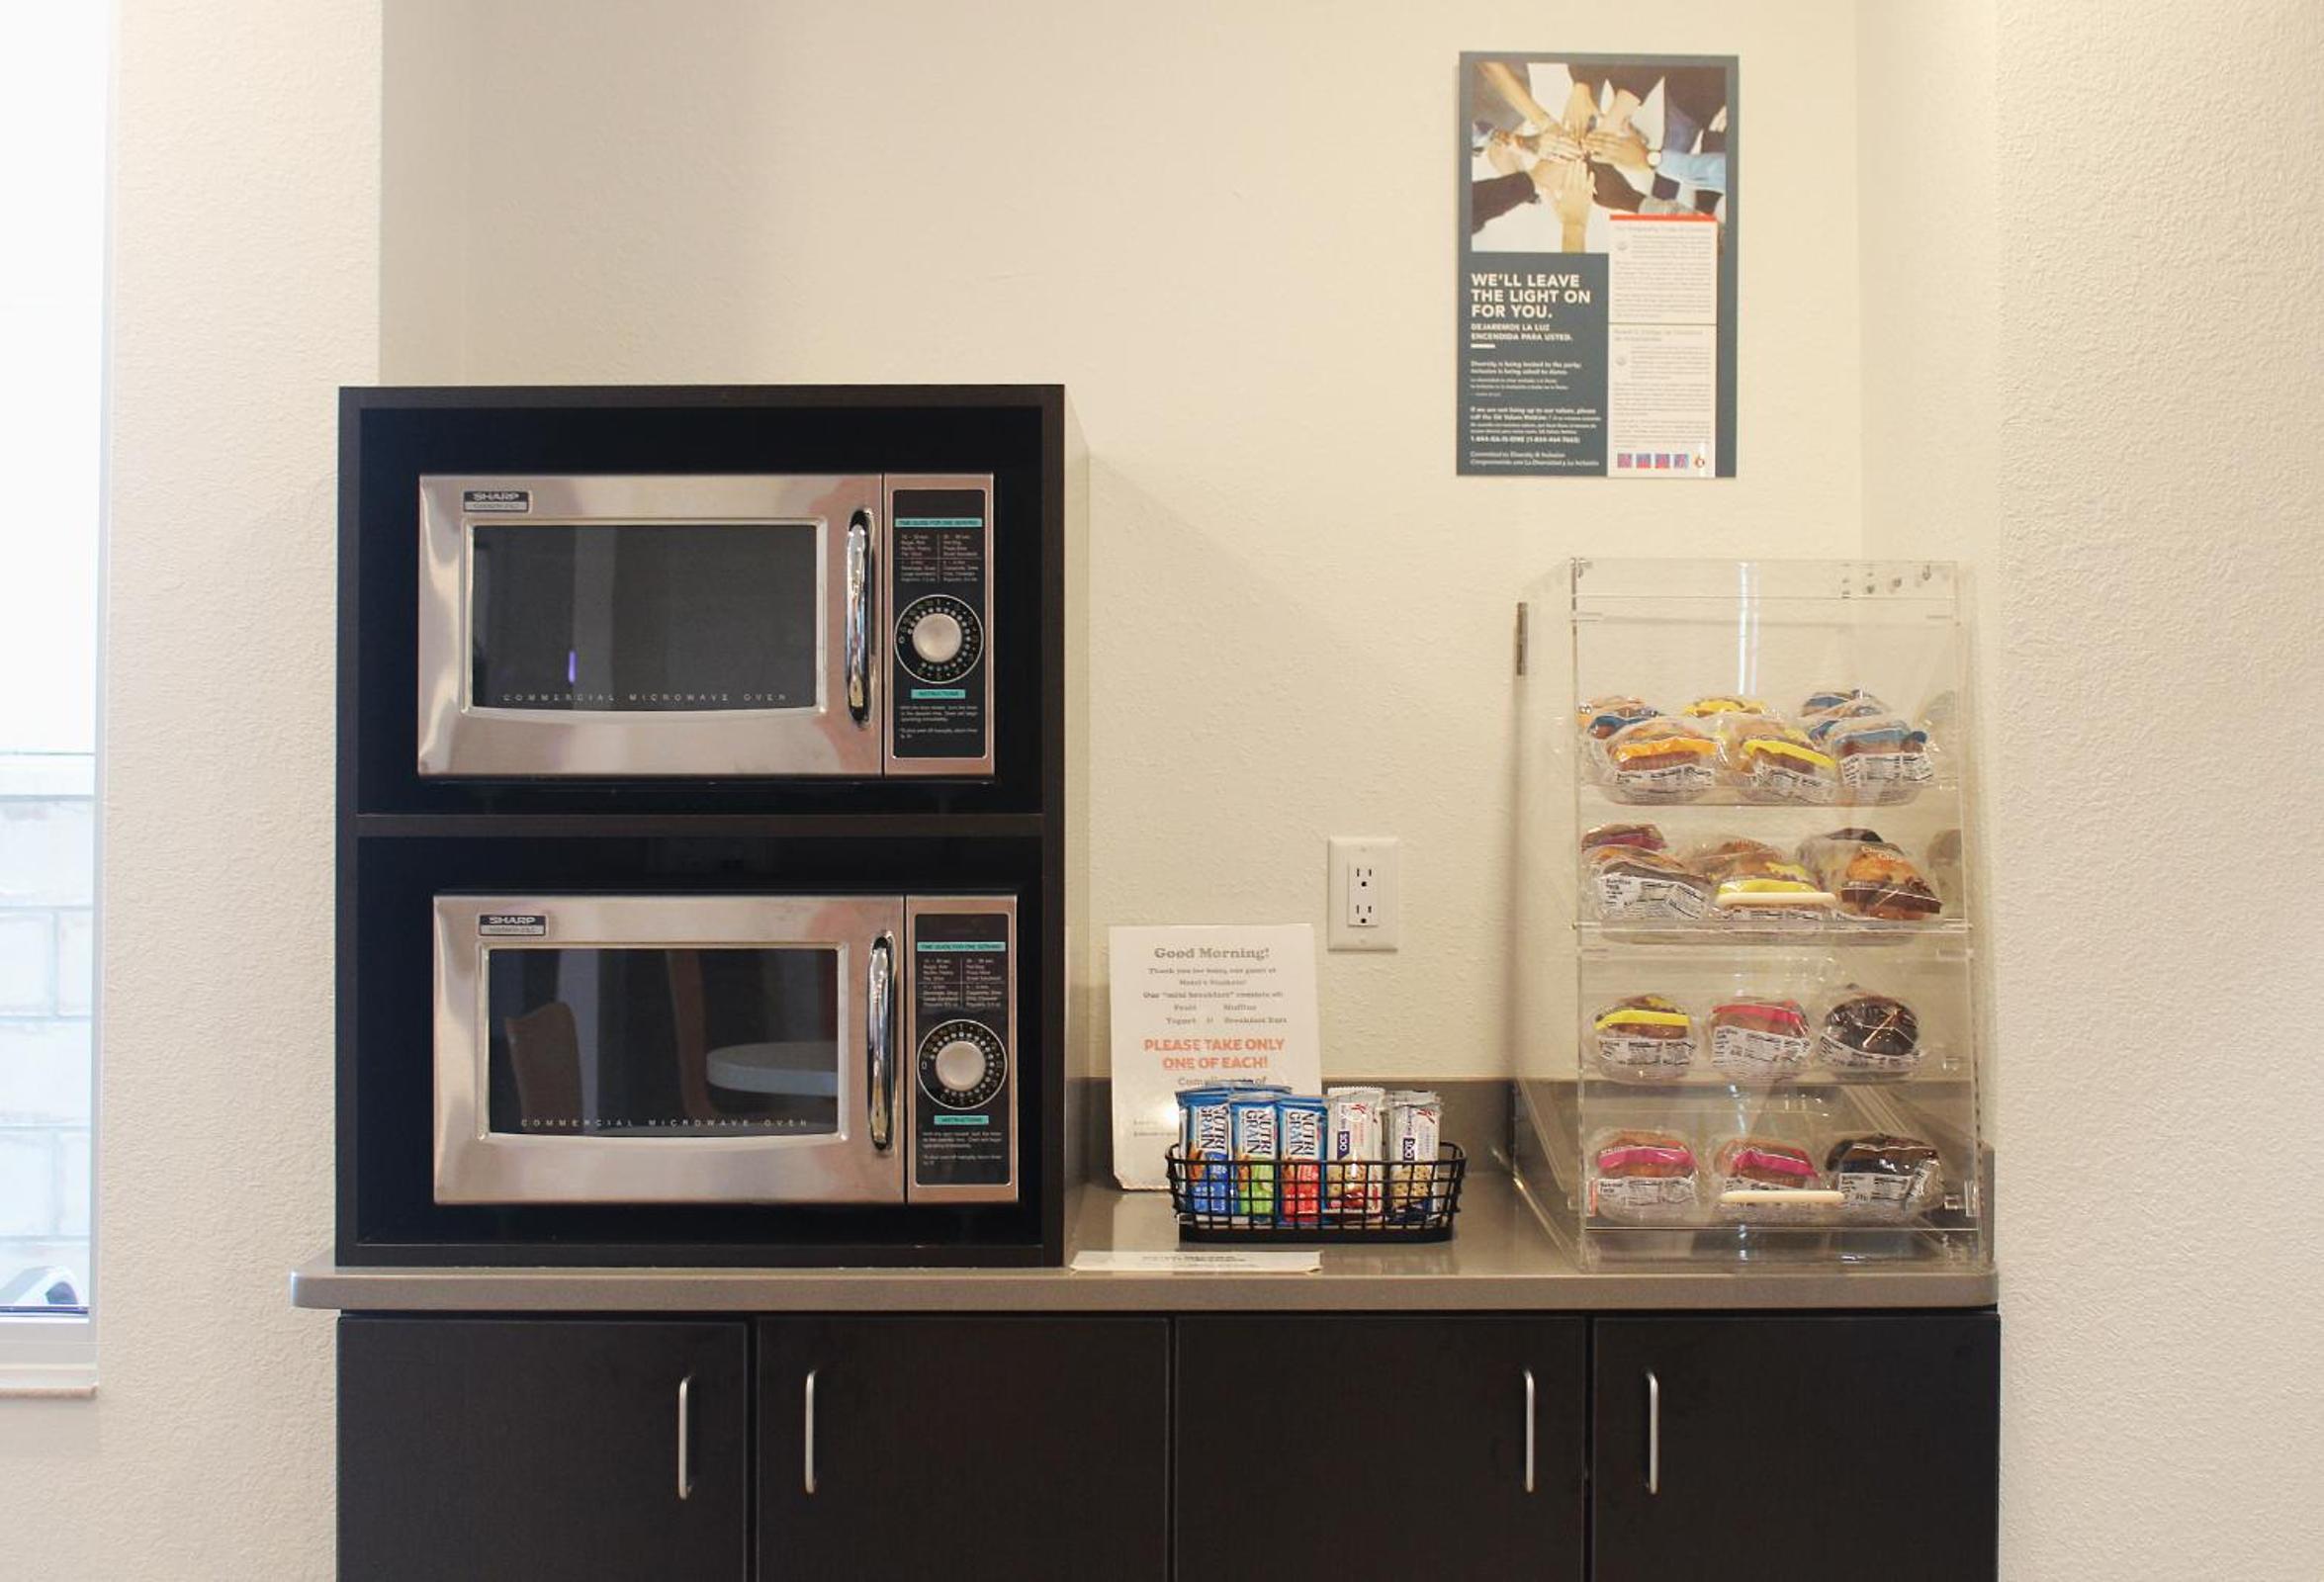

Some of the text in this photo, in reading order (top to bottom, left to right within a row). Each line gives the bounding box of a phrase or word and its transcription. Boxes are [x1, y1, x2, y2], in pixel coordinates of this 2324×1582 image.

[1471, 273, 1580, 287] WE'LL LEAVE
[1471, 289, 1590, 304] THE LIGHT ON
[1471, 305, 1553, 318] FOR YOU.
[473, 492, 520, 501] SHARP
[1154, 947, 1270, 961] Good Morning!
[1144, 1038, 1285, 1051] PLEASE TAKE ONLY
[1163, 1056, 1268, 1069] ONE OF EACH!
[521, 1118, 807, 1127] COMMERCIAL MICROWAVE OVEN
[1246, 1110, 1260, 1155] GRAIN
[1258, 1110, 1272, 1155] NUTRI
[1289, 1111, 1303, 1156] GRAIN
[1301, 1112, 1315, 1156] NUTRI
